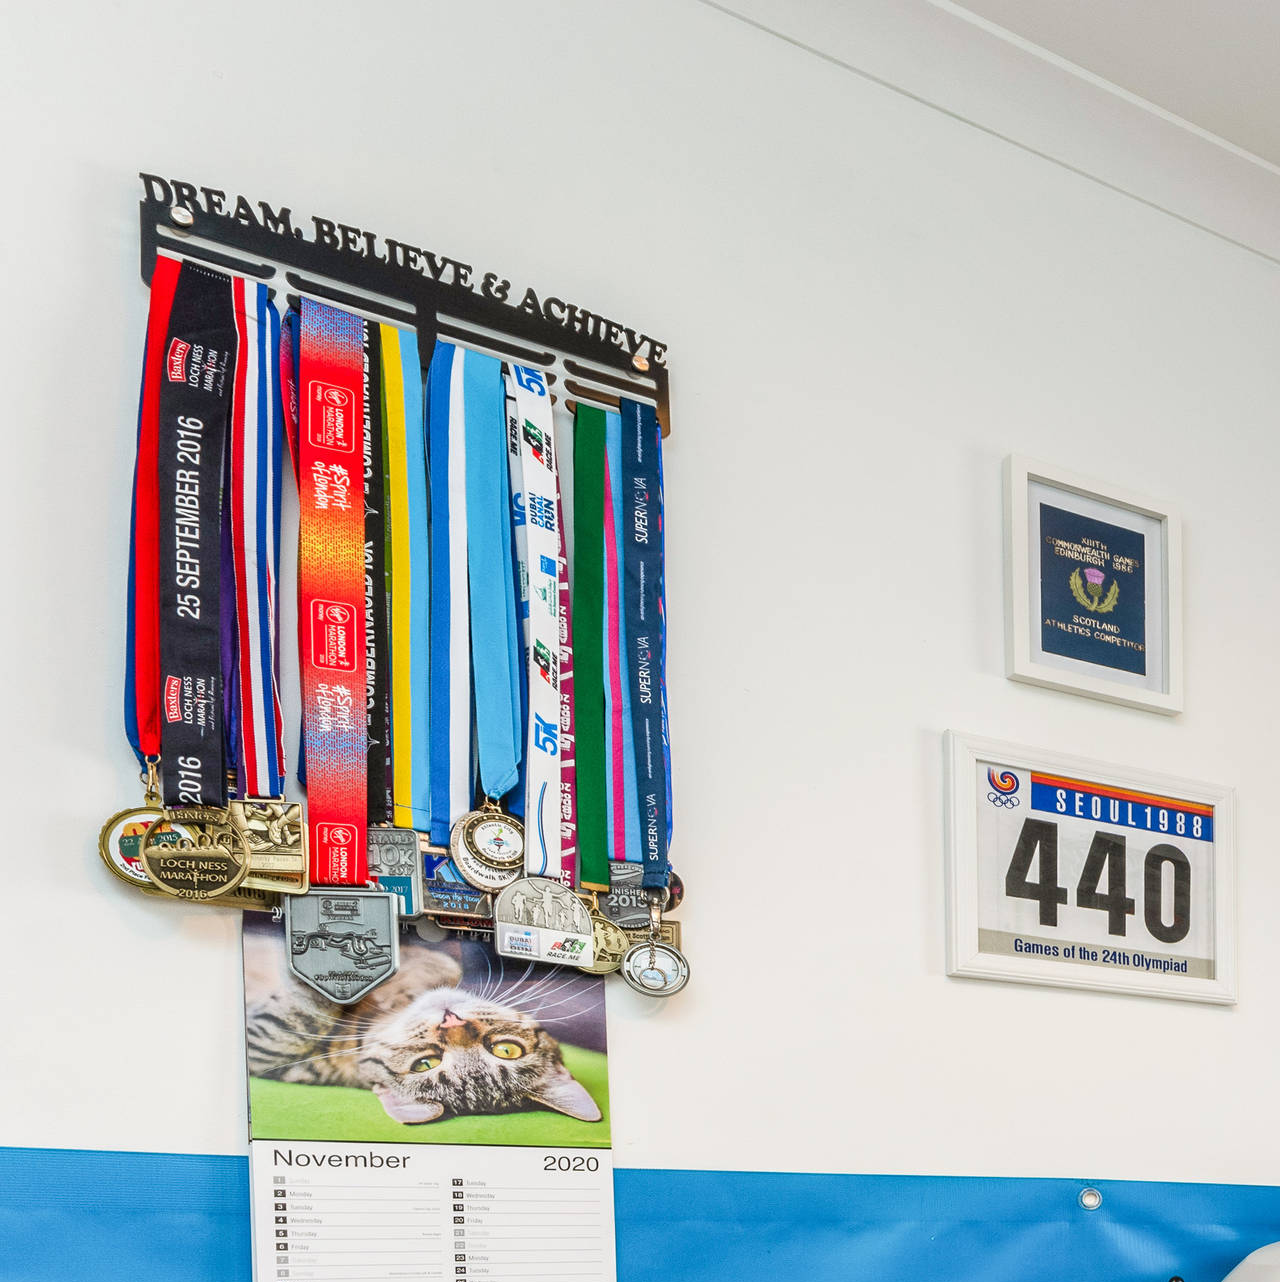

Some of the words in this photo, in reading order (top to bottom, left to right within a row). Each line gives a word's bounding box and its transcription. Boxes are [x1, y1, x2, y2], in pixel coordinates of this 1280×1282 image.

[139, 172, 304, 239] DREAM,
[312, 215, 474, 289] BELIEVE
[480, 272, 511, 301] &
[517, 288, 668, 368] ACHIEVE
[191, 344, 204, 366] NESS
[188, 366, 199, 388] LOCH
[335, 408, 344, 439] LONDON
[177, 415, 204, 466] 2016
[529, 492, 537, 525] DUBAI
[537, 496, 545, 528] CANAL
[544, 498, 555, 532] RUN
[176, 469, 200, 590] SEPTEMBER
[1046, 536, 1110, 560] COMMONWEALTH
[1113, 555, 1139, 568] GAMES
[1055, 548, 1105, 567] EDINBURGH
[177, 594, 200, 620] 25
[1045, 618, 1091, 637] ATHLETICS
[1073, 615, 1120, 633] SCOTLAND
[338, 626, 346, 657] LONDON
[183, 676, 193, 698] NESS
[184, 700, 193, 724] LOCH
[535, 712, 558, 756] 5K
[178, 756, 202, 804] 2016
[160, 858, 195, 871] LOCH
[199, 860, 228, 871] NESS
[160, 871, 228, 882] MARATHON
[331, 847, 339, 884] MARATHO
[178, 887, 208, 899] 2016
[1005, 818, 1191, 944] 440
[1014, 938, 1059, 957] Games
[1063, 946, 1075, 959] of
[1079, 947, 1098, 962] the
[1102, 950, 1130, 966] 24th
[1132, 953, 1188, 973] Olympiad
[273, 1149, 411, 1169] November
[543, 1155, 599, 1172] 2020
